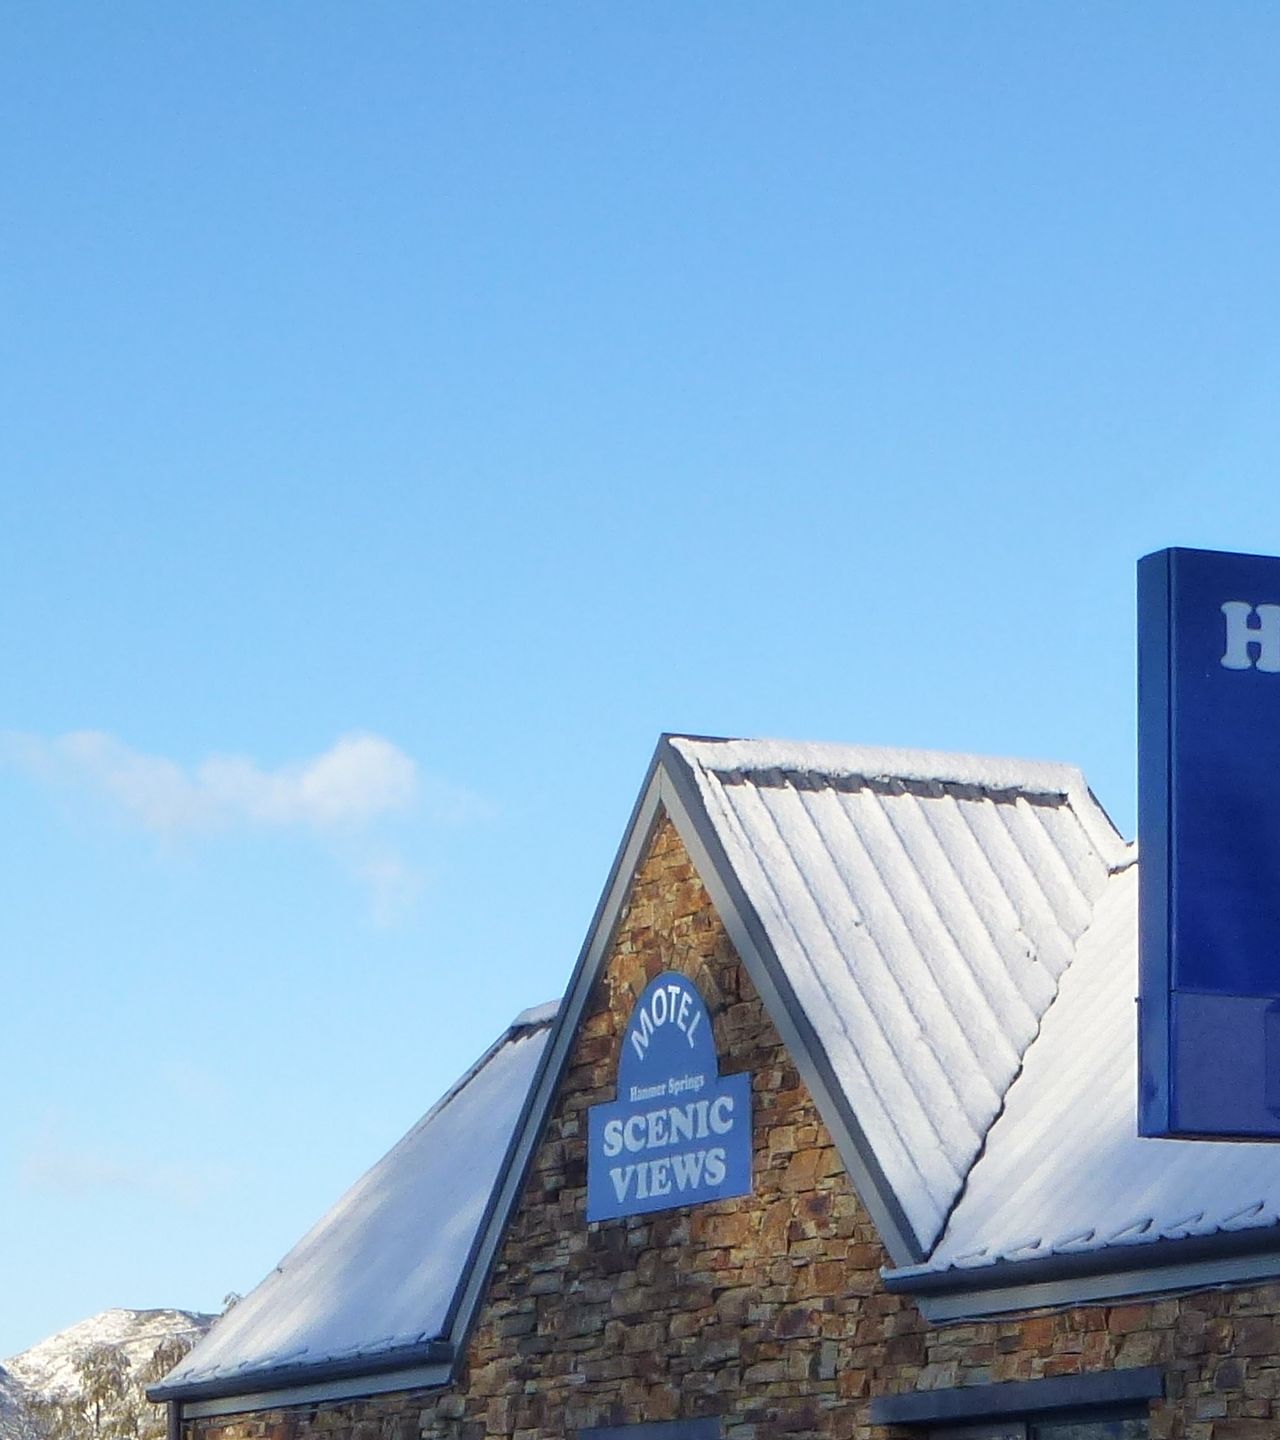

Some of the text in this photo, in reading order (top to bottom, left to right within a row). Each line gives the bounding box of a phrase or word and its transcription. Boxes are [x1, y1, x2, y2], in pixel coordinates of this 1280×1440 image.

[630, 985, 702, 1061] MOTEL
[602, 1096, 735, 1157] SCENIC
[609, 1147, 727, 1204] VIEWS
